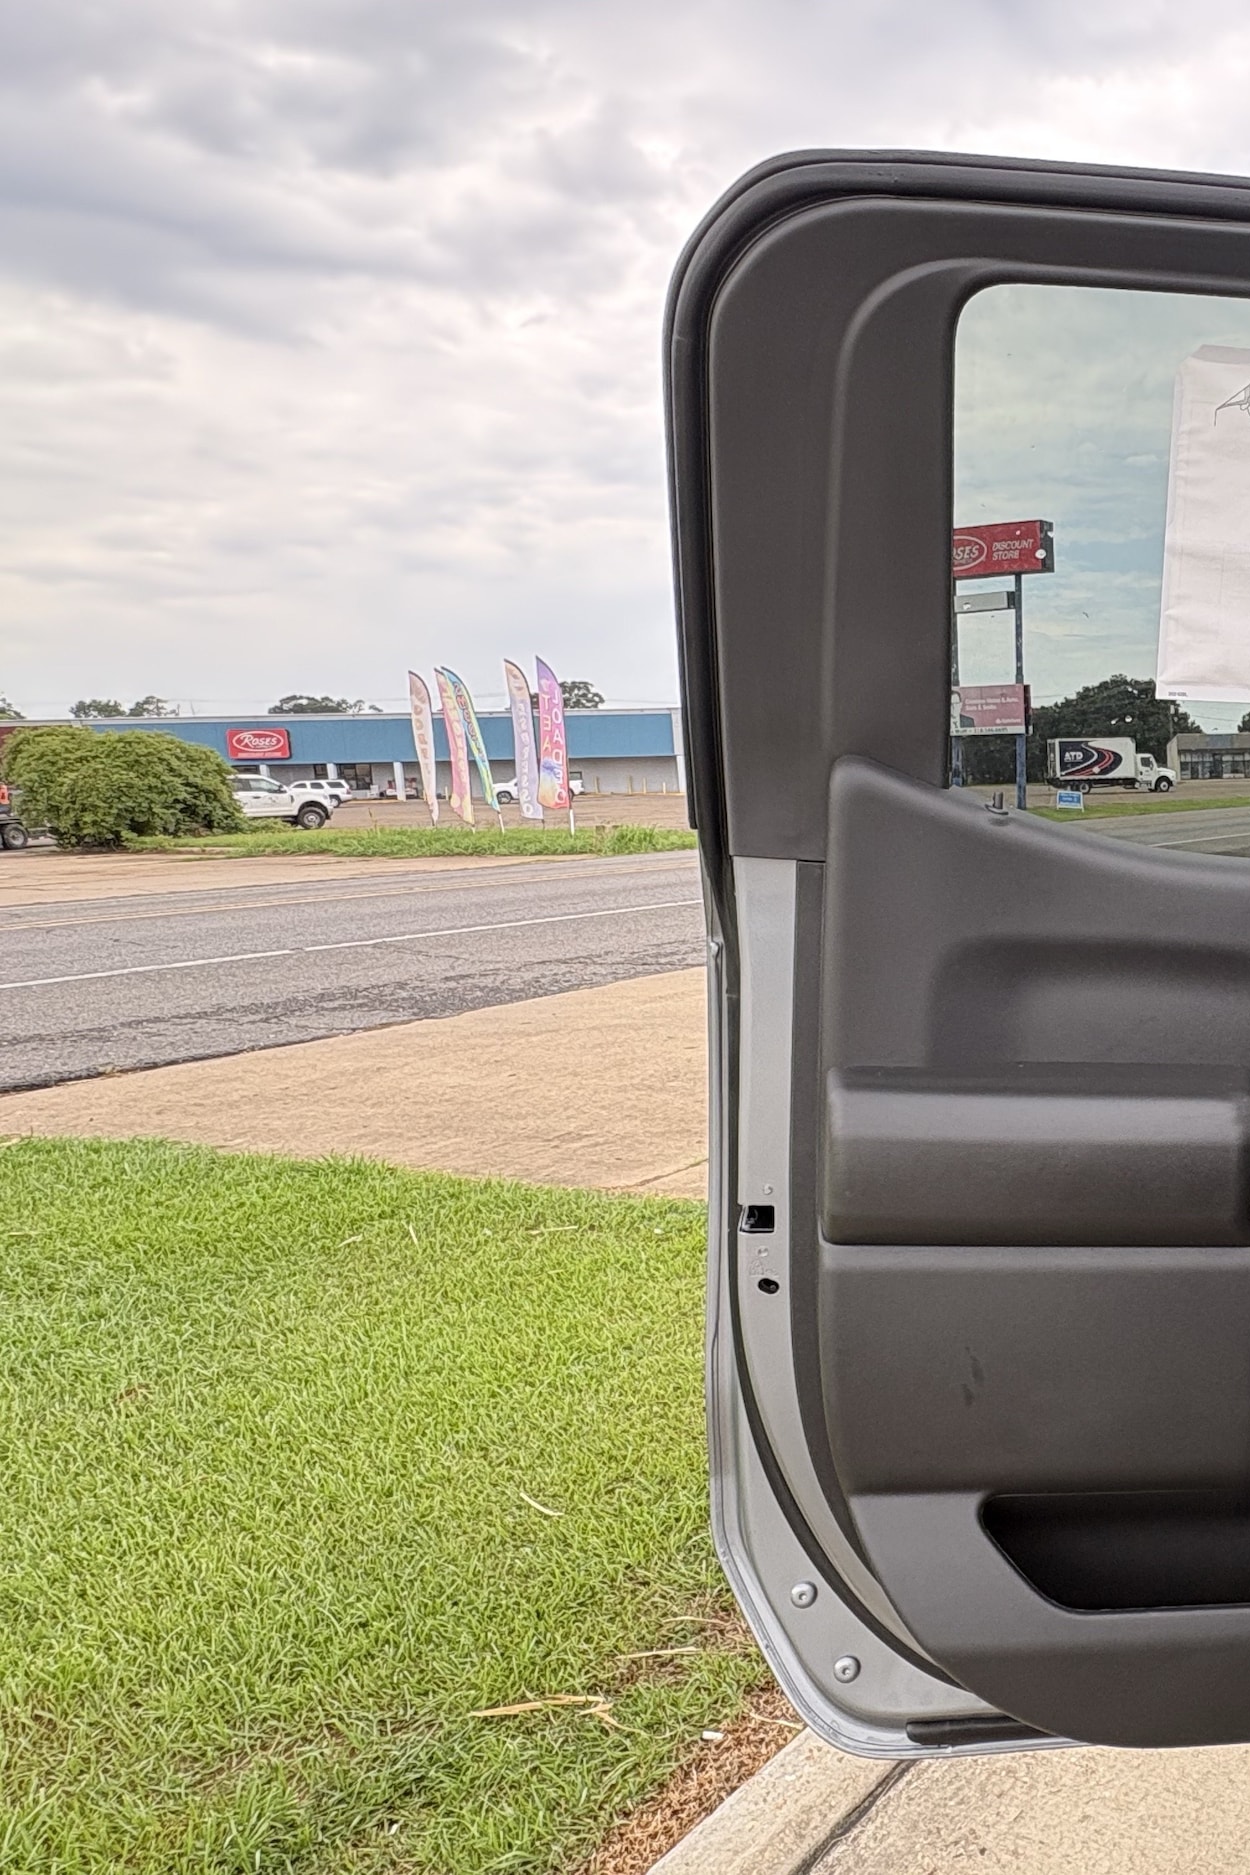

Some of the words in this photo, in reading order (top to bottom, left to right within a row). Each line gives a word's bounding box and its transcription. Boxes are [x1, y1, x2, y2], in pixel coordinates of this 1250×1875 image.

[992, 539, 1034, 551] DISCOUNT
[992, 550, 1020, 561] STORE
[1064, 751, 1084, 761] ATD
